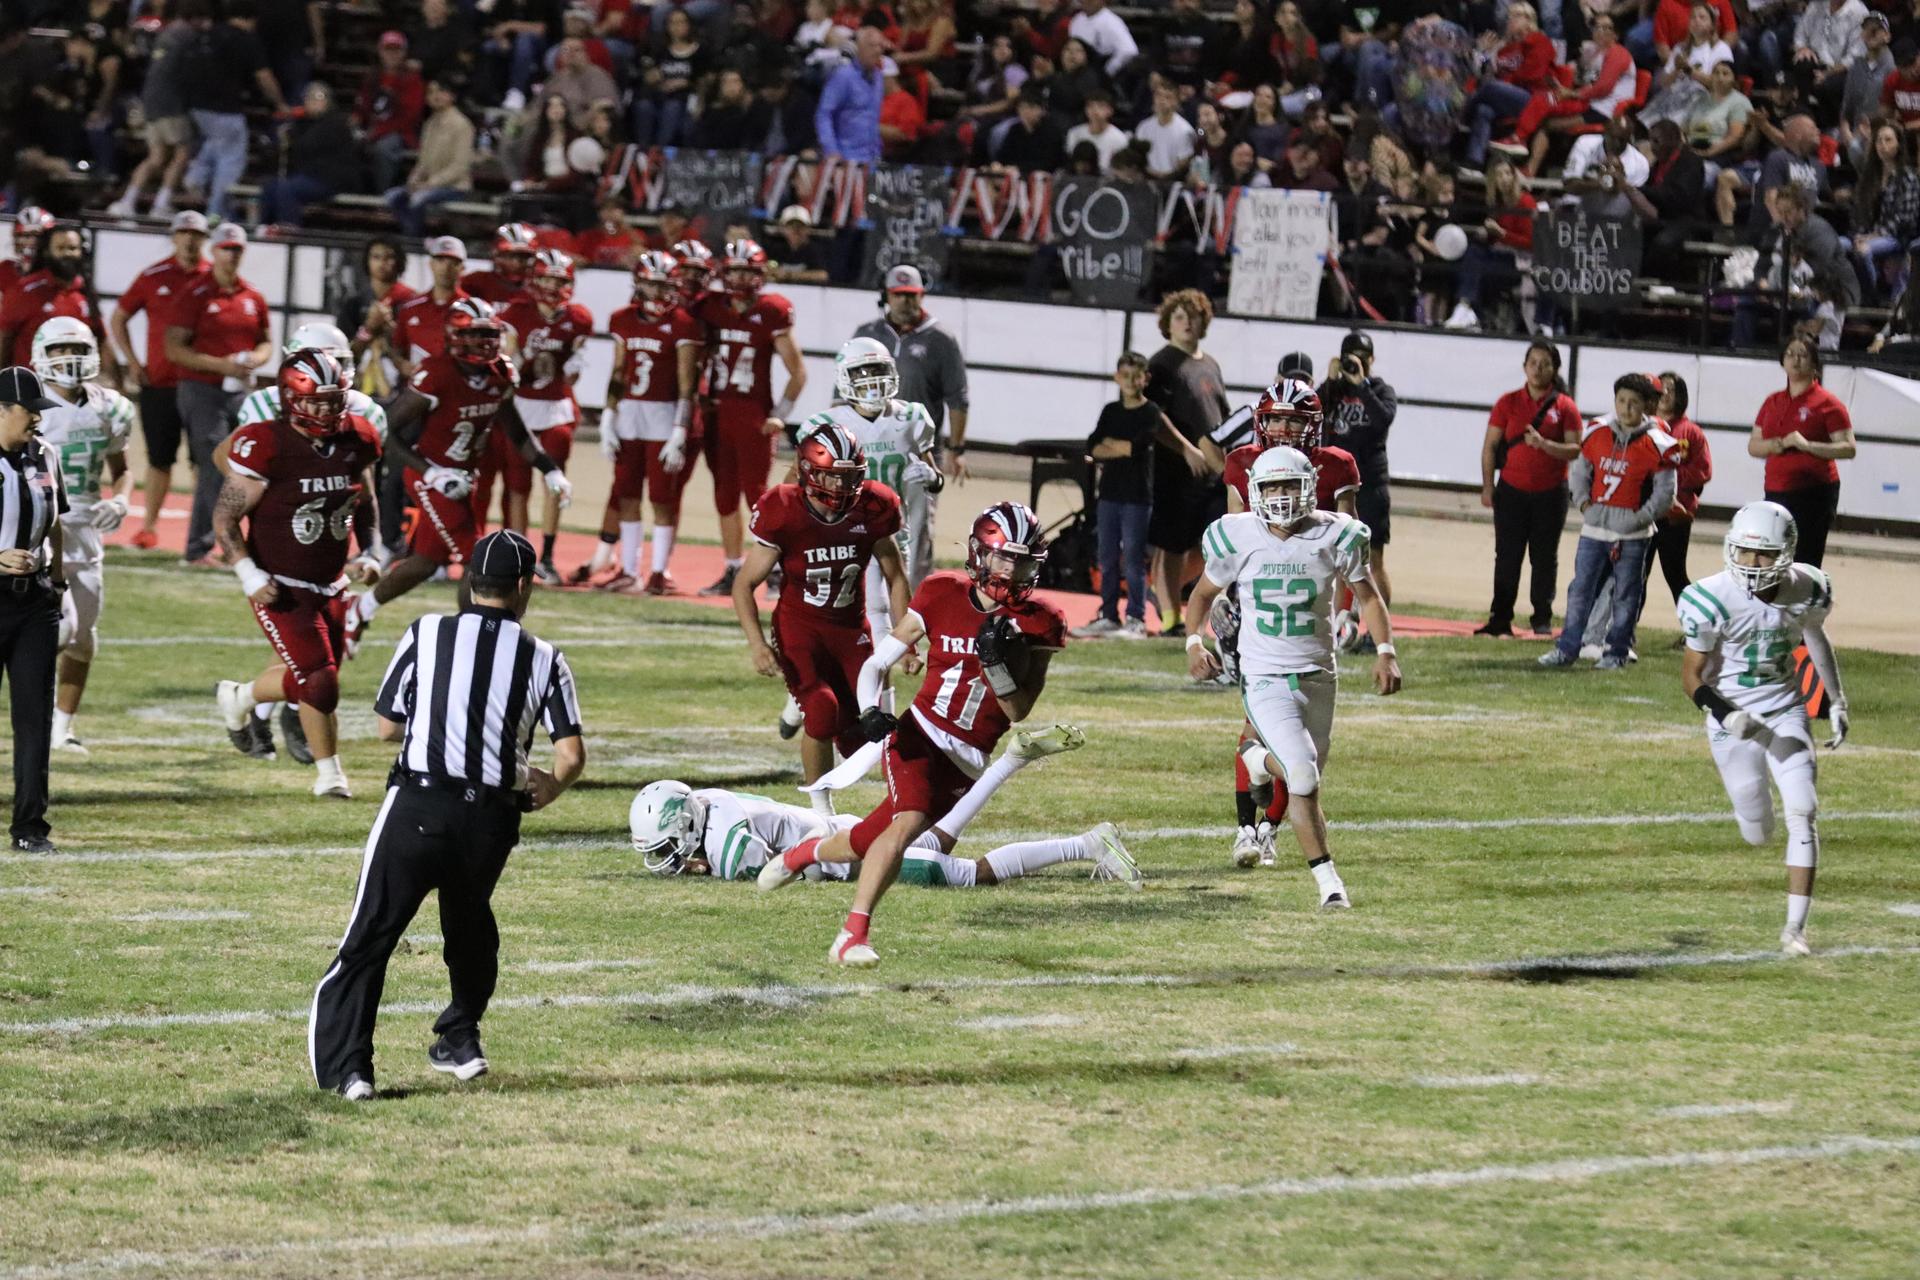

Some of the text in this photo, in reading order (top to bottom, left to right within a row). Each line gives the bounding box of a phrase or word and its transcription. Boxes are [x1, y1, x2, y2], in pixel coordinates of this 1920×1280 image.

[1056, 184, 1130, 240] GO
[1557, 217, 1622, 249] BEAT
[1571, 245, 1608, 270] THE
[1532, 266, 1632, 295] COWBOYS
[631, 352, 653, 396] 3
[1597, 474, 1622, 502] 7
[291, 497, 357, 545] 66
[803, 545, 858, 564] TRIBE
[803, 563, 862, 608] 52
[1252, 577, 1318, 637] 52
[1680, 609, 1698, 639] 13
[940, 634, 979, 655] TRI
[1737, 639, 1797, 689] 13
[931, 659, 988, 731] 11
